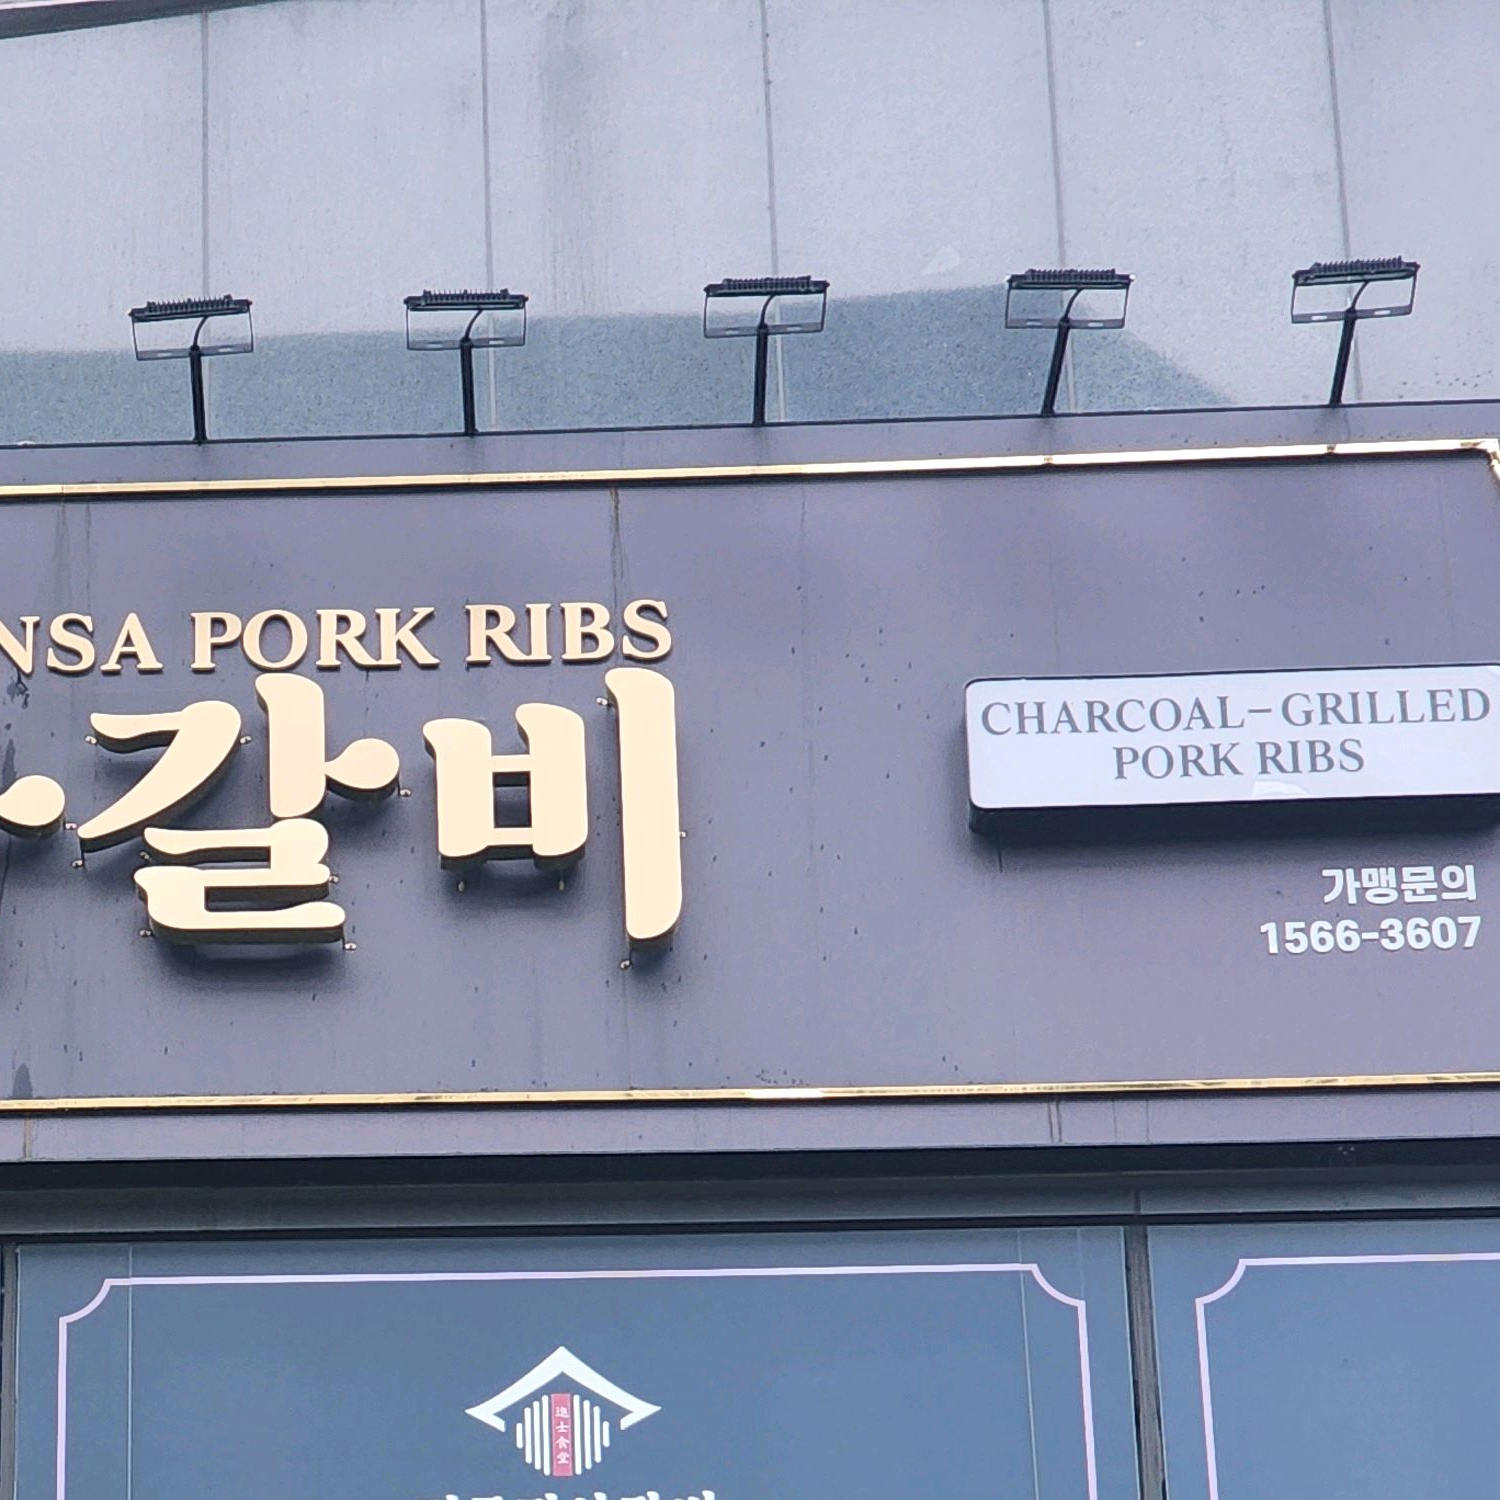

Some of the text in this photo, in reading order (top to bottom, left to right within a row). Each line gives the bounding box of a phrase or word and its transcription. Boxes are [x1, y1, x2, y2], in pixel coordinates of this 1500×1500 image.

[191, 606, 440, 673] PORK
[465, 599, 672, 664] RIBS
[981, 687, 1491, 736] CHARCOAL-GRILLED
[1113, 738, 1365, 780] PORK RIBS
[1322, 864, 1477, 905] 가맹문의
[1260, 915, 1482, 955] 1566-3607
